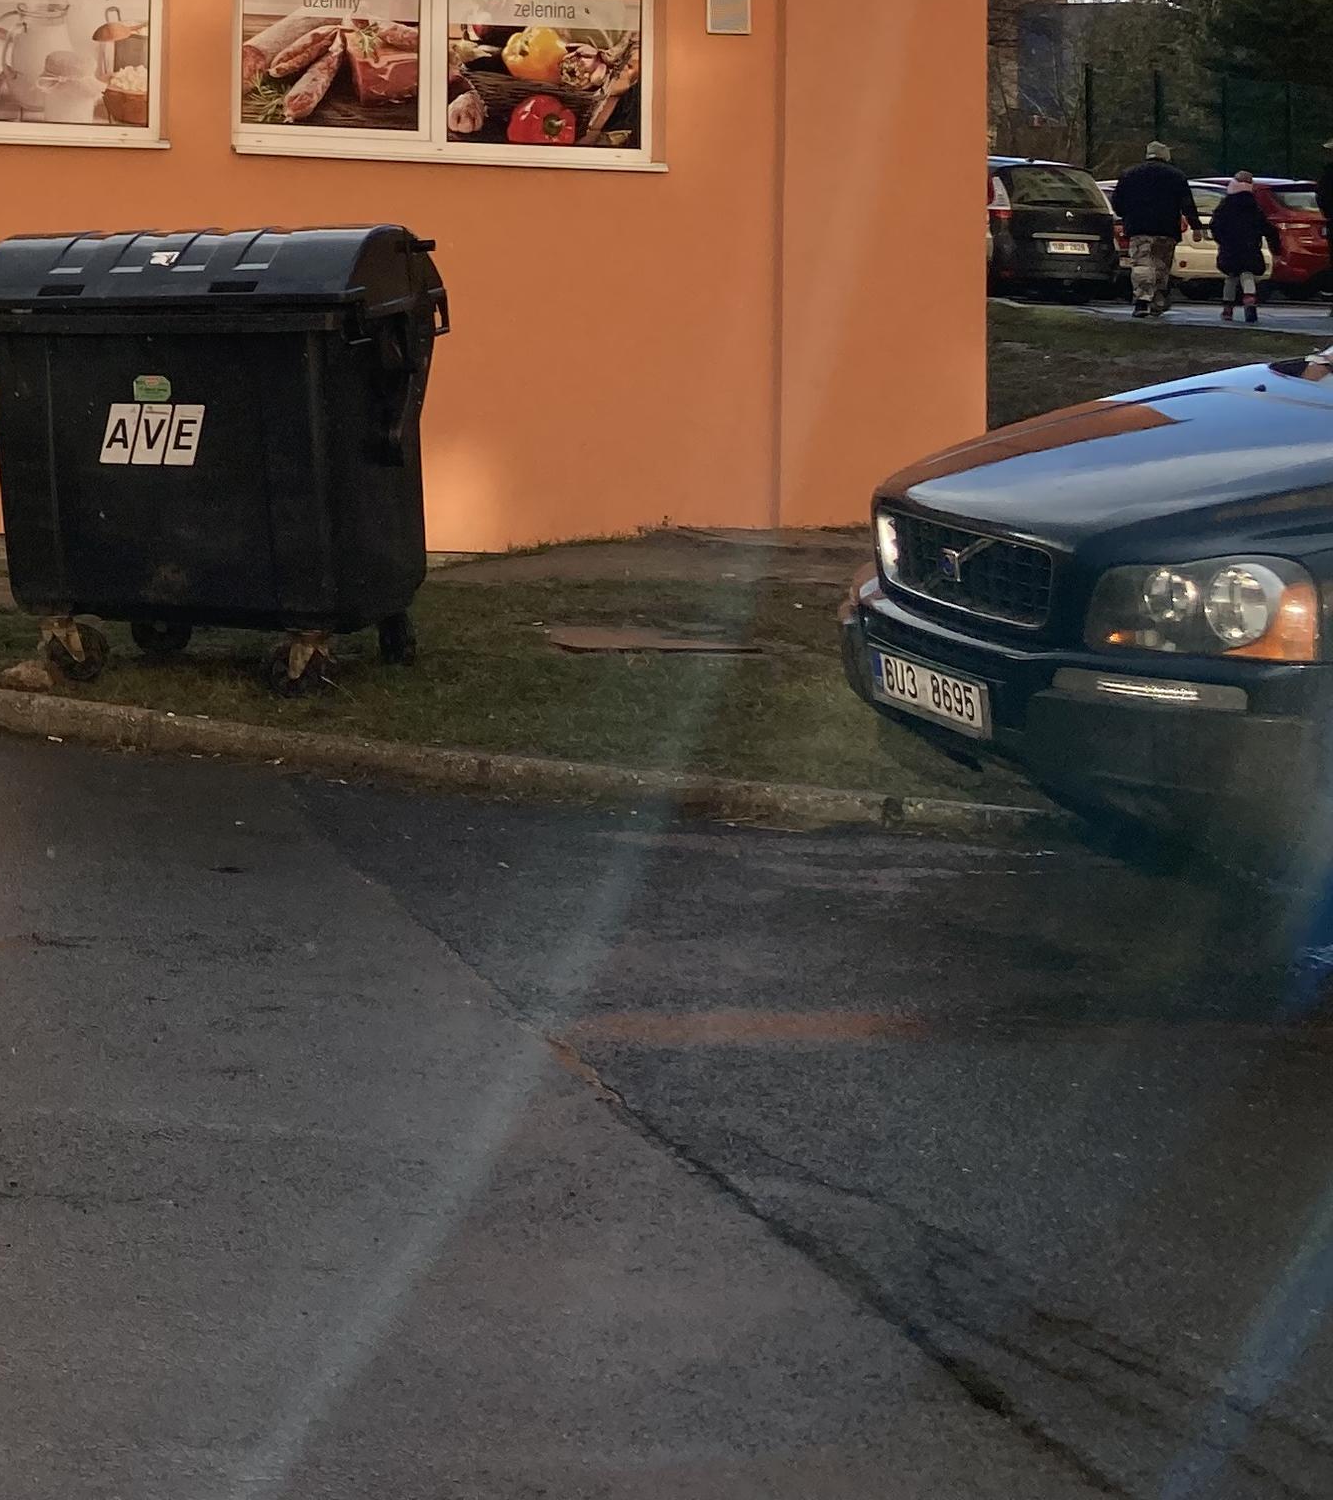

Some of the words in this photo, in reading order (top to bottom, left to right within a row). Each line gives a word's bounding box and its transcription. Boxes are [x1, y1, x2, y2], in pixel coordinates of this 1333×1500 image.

[513, 1, 576, 19] zelenina
[105, 417, 198, 450] AVE
[884, 657, 918, 699] 6U3
[930, 673, 975, 721] 8695
